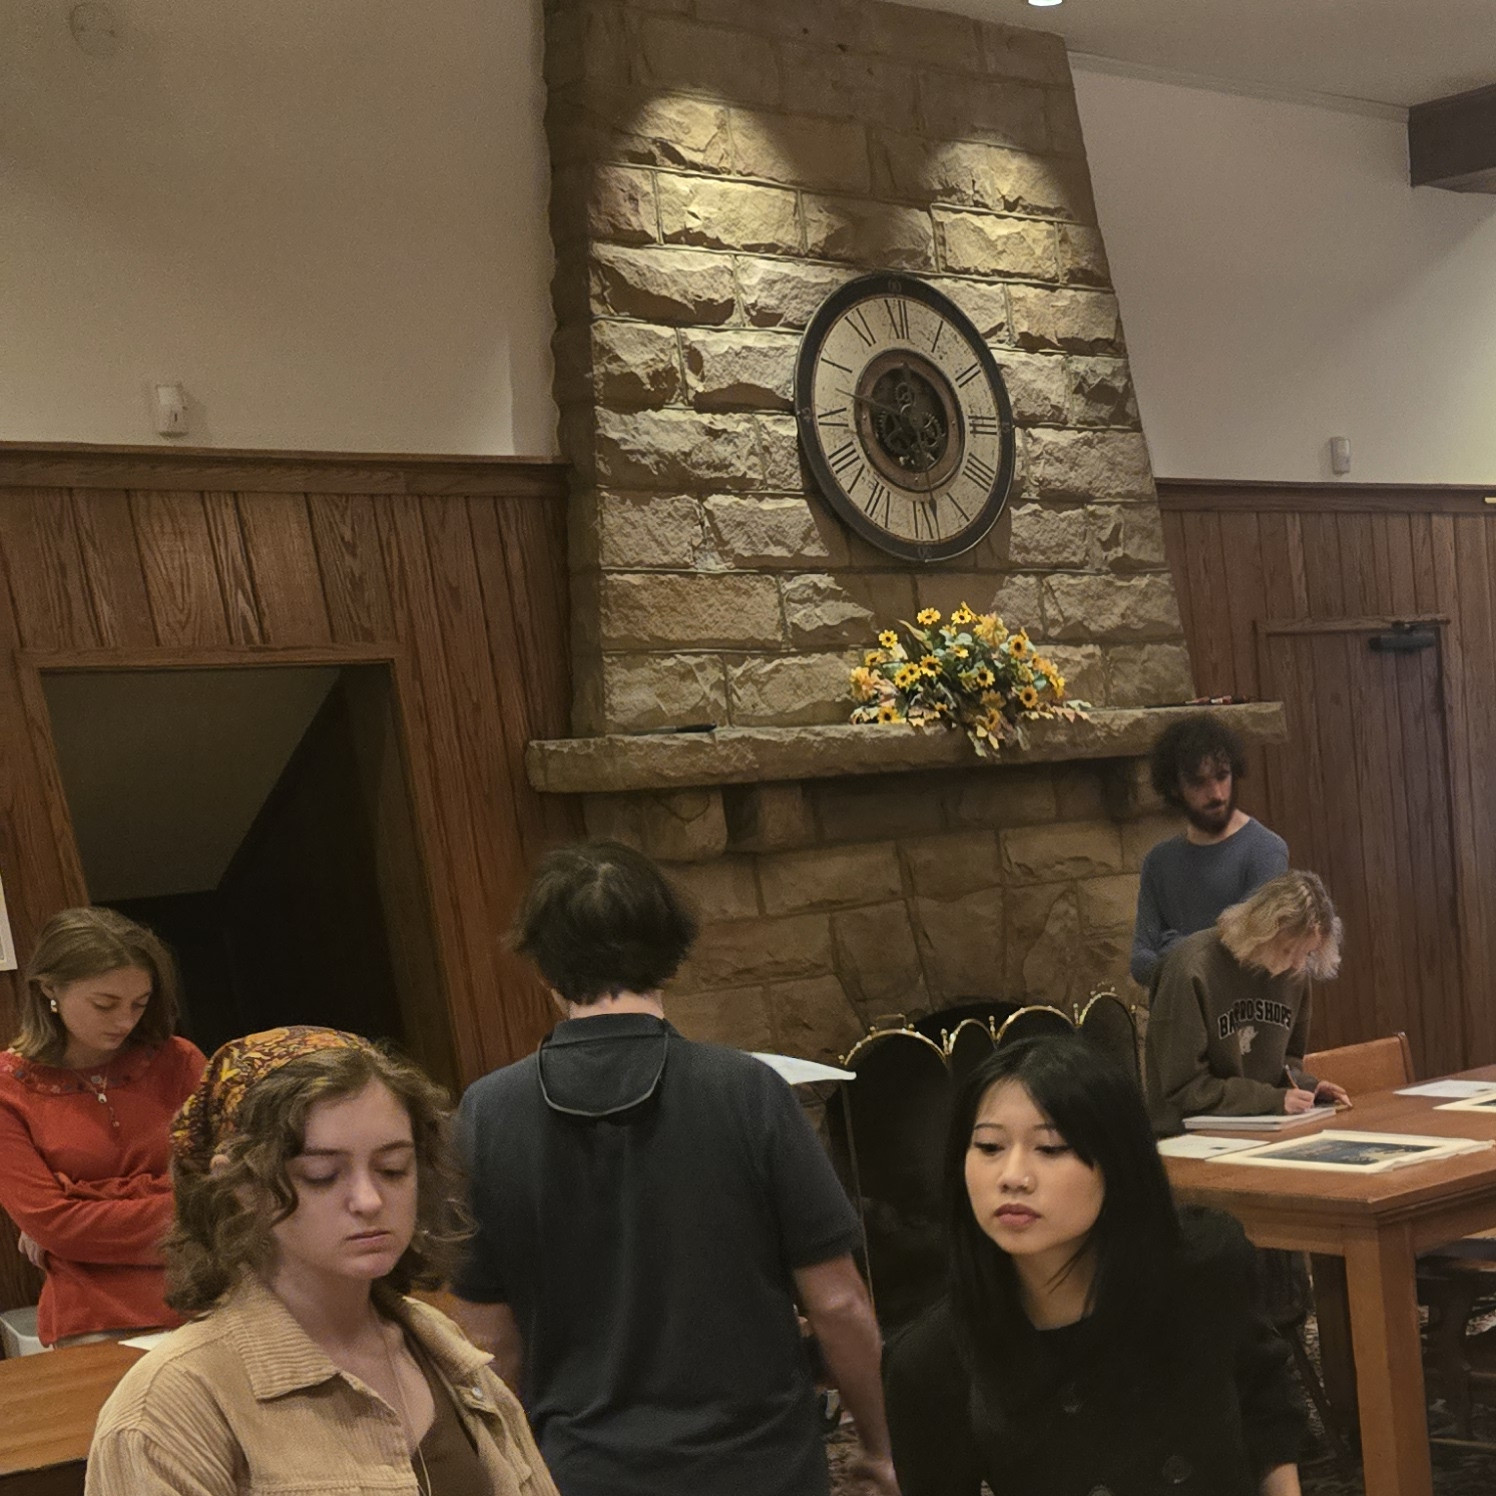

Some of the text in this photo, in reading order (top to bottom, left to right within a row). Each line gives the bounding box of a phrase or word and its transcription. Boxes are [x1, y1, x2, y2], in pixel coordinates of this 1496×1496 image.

[883, 298, 911, 340] XII
[955, 362, 983, 388] II
[967, 414, 998, 436] III
[1255, 998, 1292, 1030] SHOPS
